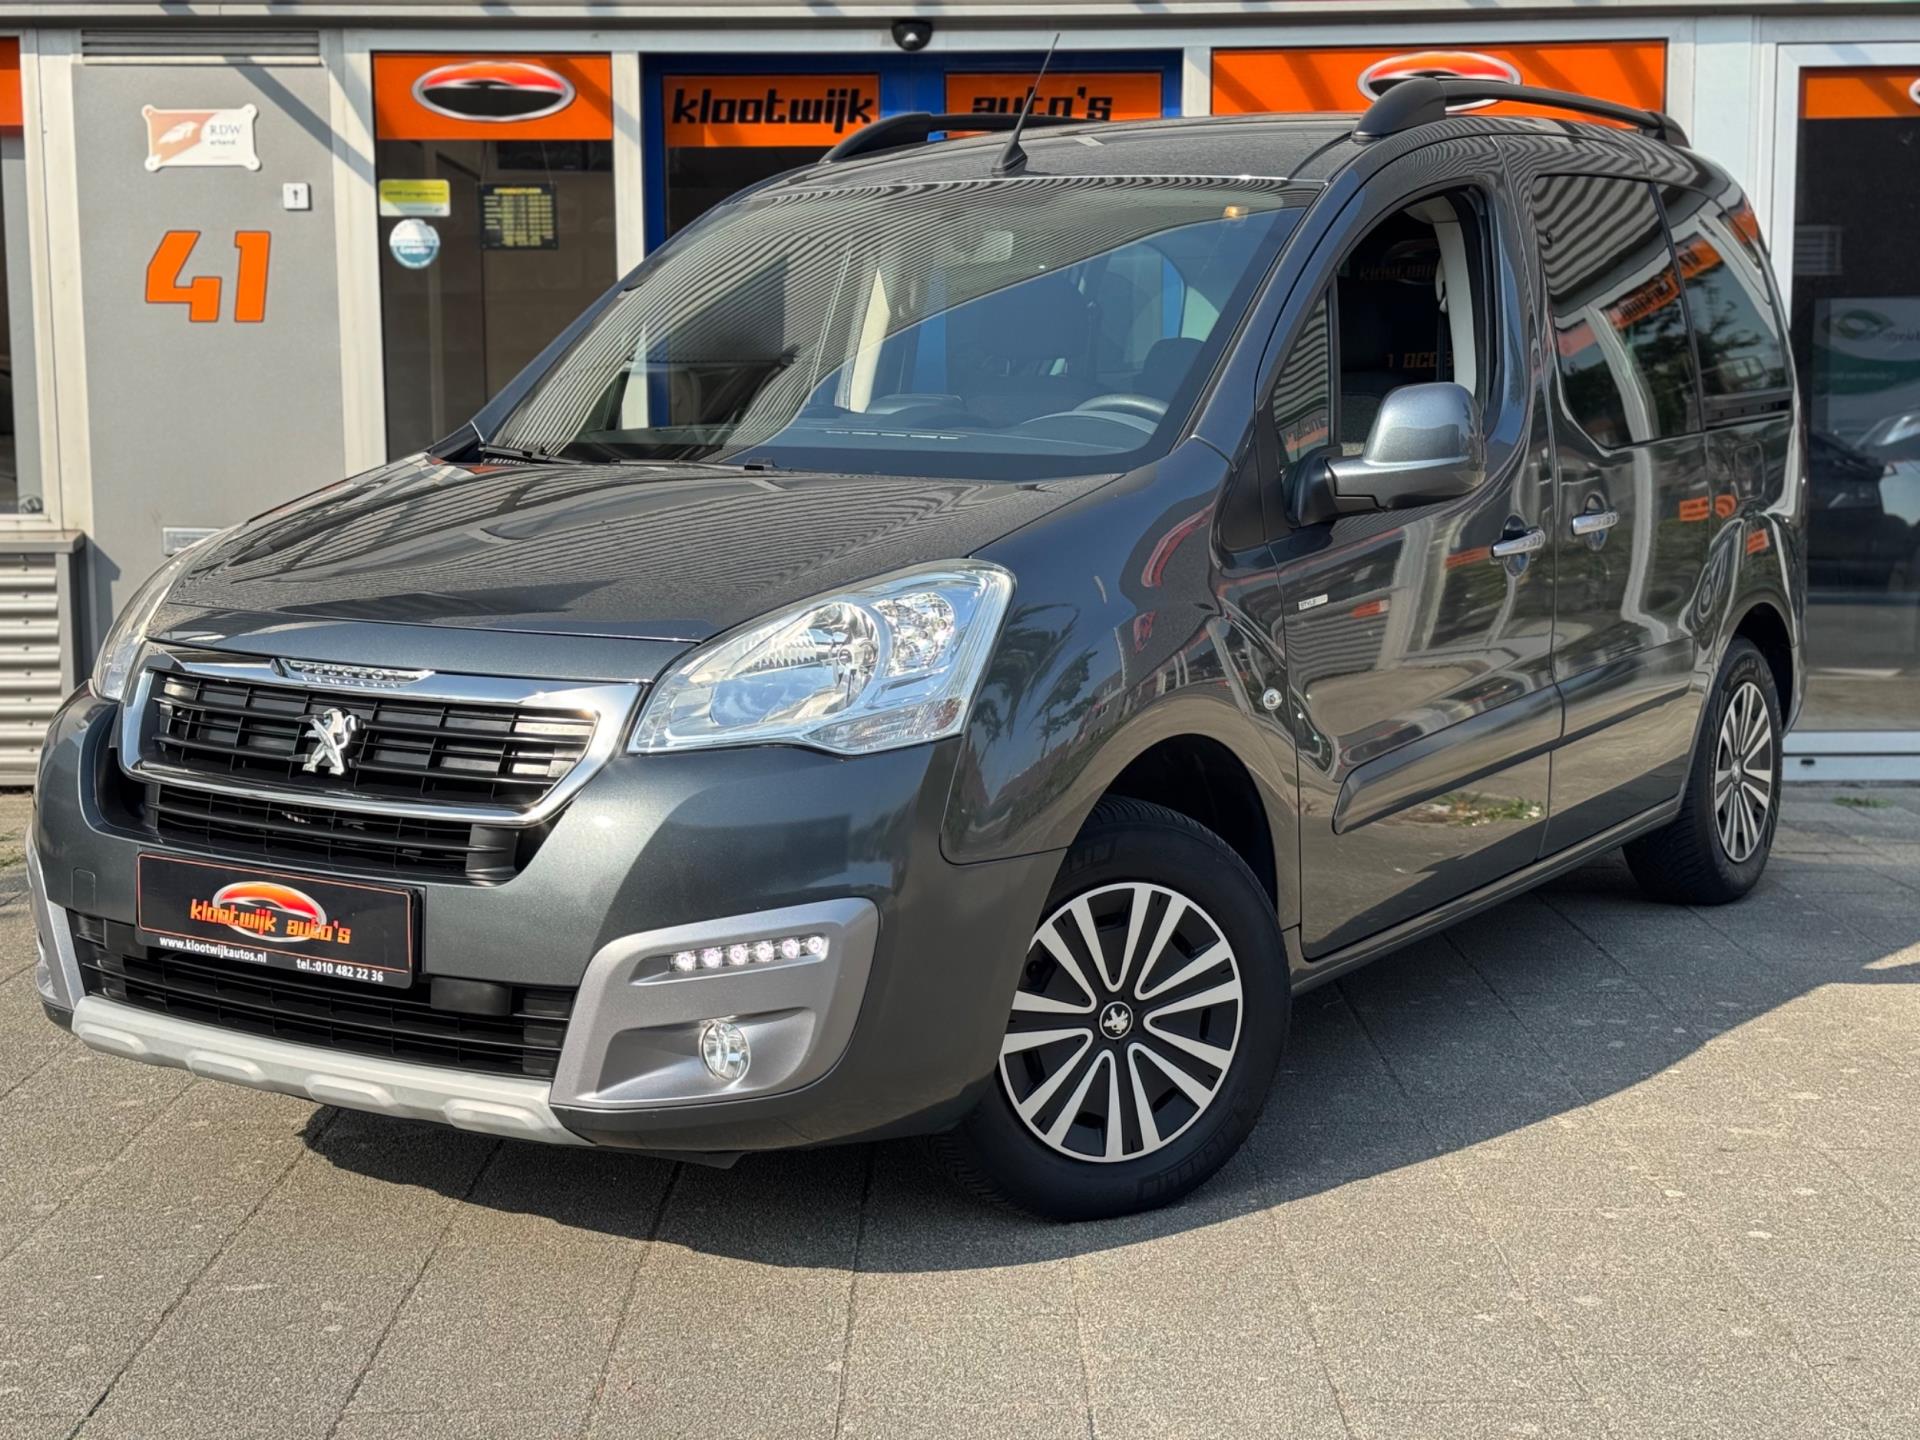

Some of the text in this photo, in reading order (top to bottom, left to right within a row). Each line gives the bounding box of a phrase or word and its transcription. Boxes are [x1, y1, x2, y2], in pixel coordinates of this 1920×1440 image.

[672, 88, 872, 133] klootwijk
[210, 124, 242, 135] RDW
[145, 230, 271, 323] 41
[190, 898, 351, 945] klootwijk auto's
[159, 936, 267, 963] www.klootwijkautos.nl
[296, 958, 384, 982] tel.:010 482 22 36
